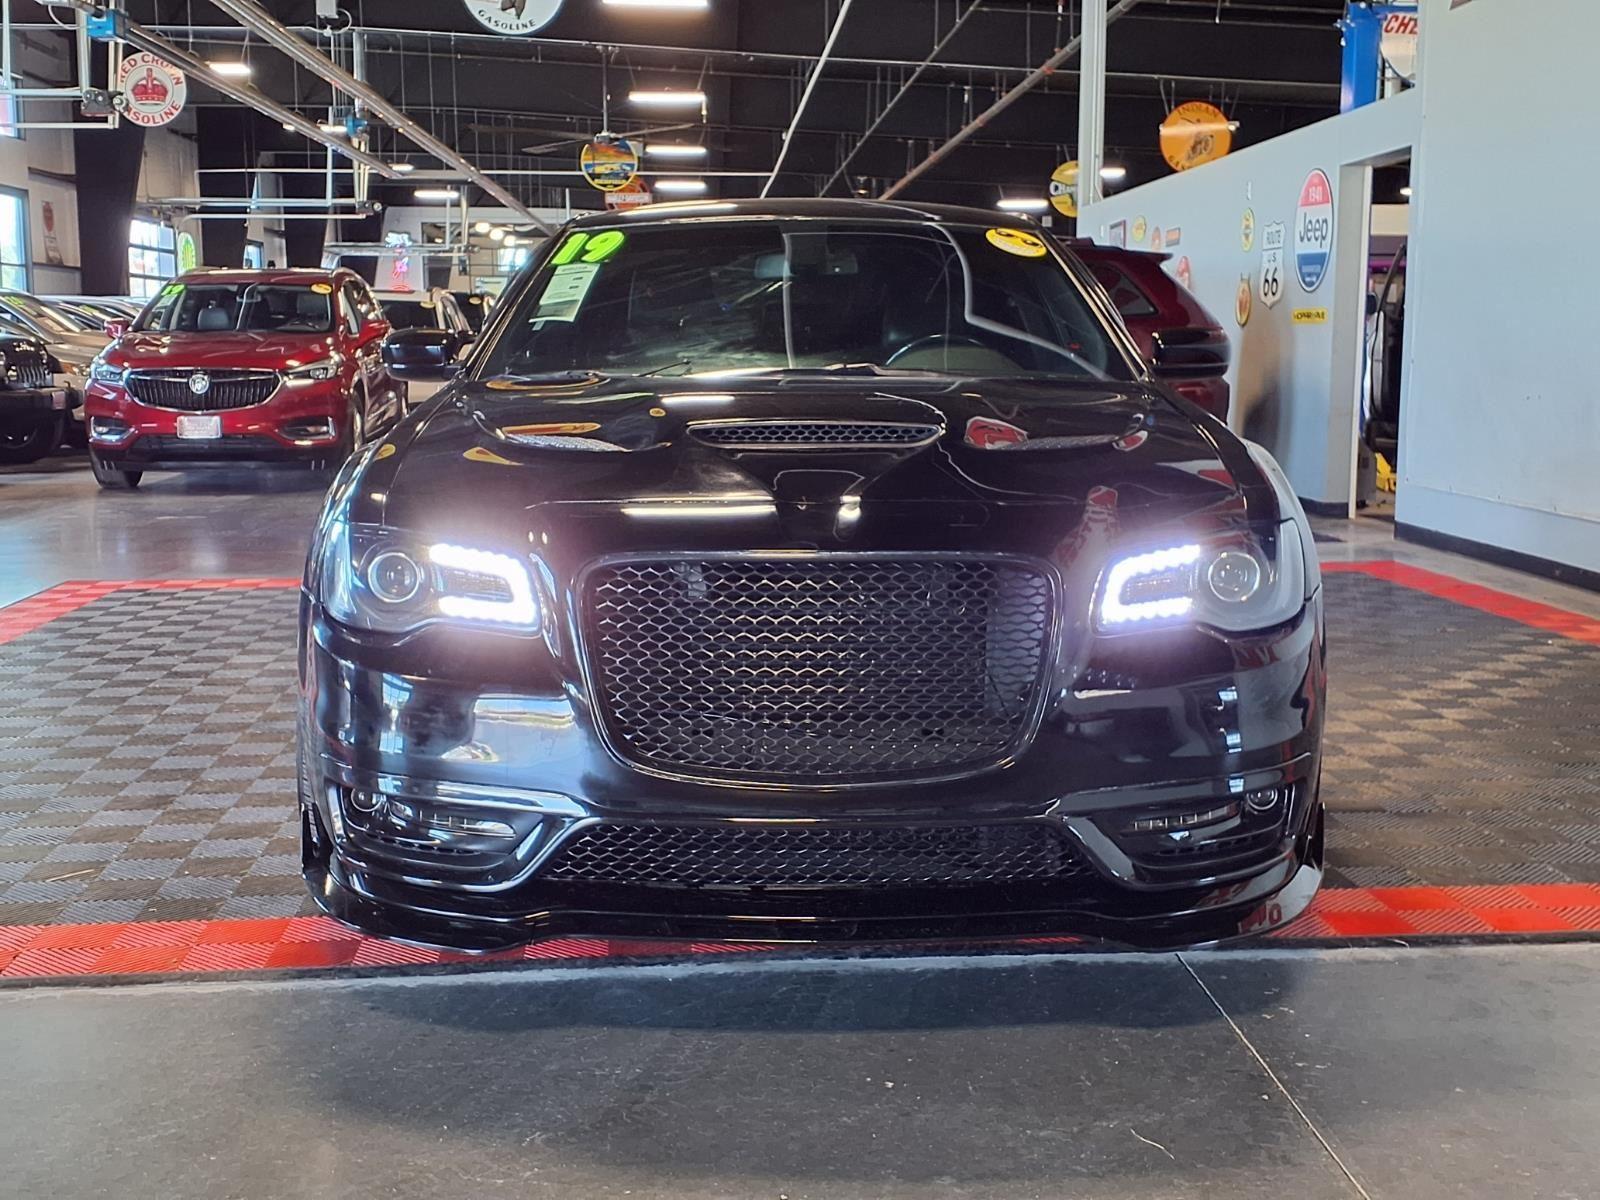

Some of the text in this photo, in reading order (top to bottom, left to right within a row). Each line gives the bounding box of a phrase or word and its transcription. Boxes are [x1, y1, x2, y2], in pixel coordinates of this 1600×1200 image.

[478, 9, 536, 30] GASOLINE
[141, 53, 184, 86] CRON
[127, 100, 181, 124] ASOLINE
[1299, 211, 1328, 248] Jeep
[550, 230, 625, 265] 19
[1263, 266, 1278, 297] 66
